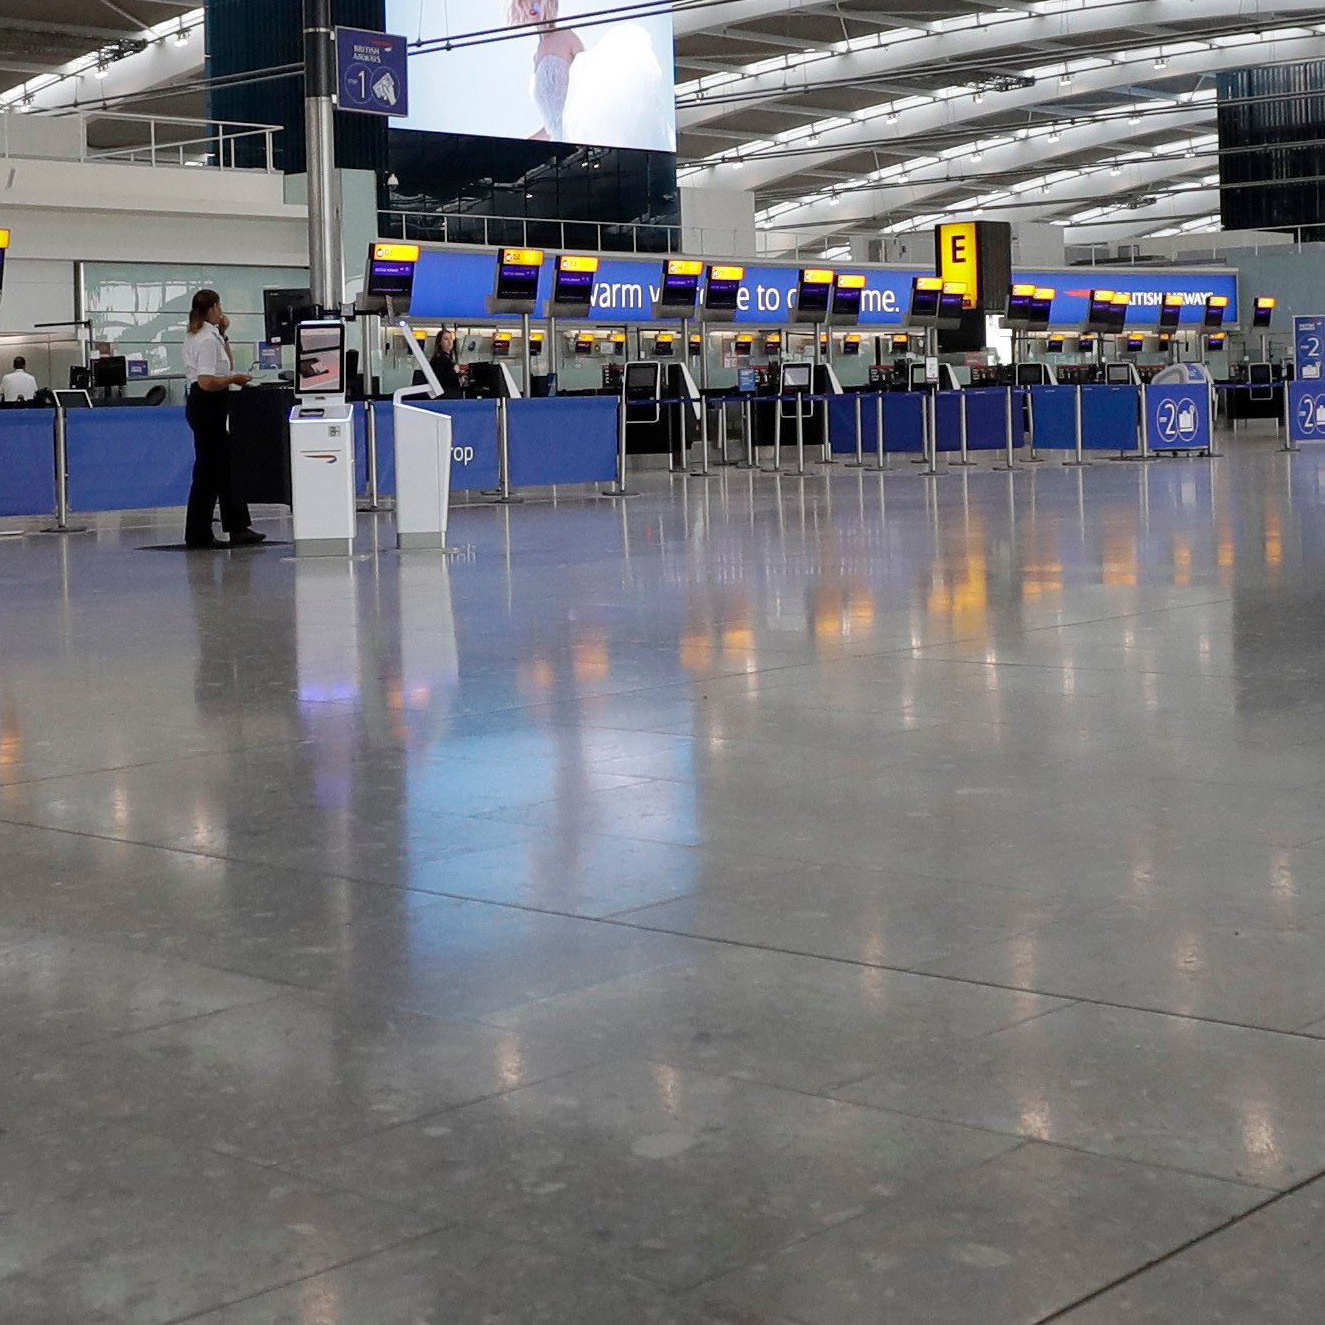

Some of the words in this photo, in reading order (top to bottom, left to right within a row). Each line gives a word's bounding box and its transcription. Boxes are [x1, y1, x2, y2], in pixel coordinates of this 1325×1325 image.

[354, 45, 380, 54] BRITISH
[358, 70, 365, 98] 1
[951, 235, 966, 263] E
[756, 285, 780, 311] to
[1307, 337, 1319, 356] 2
[1165, 403, 1176, 434] 2
[1304, 398, 1313, 427] 2
